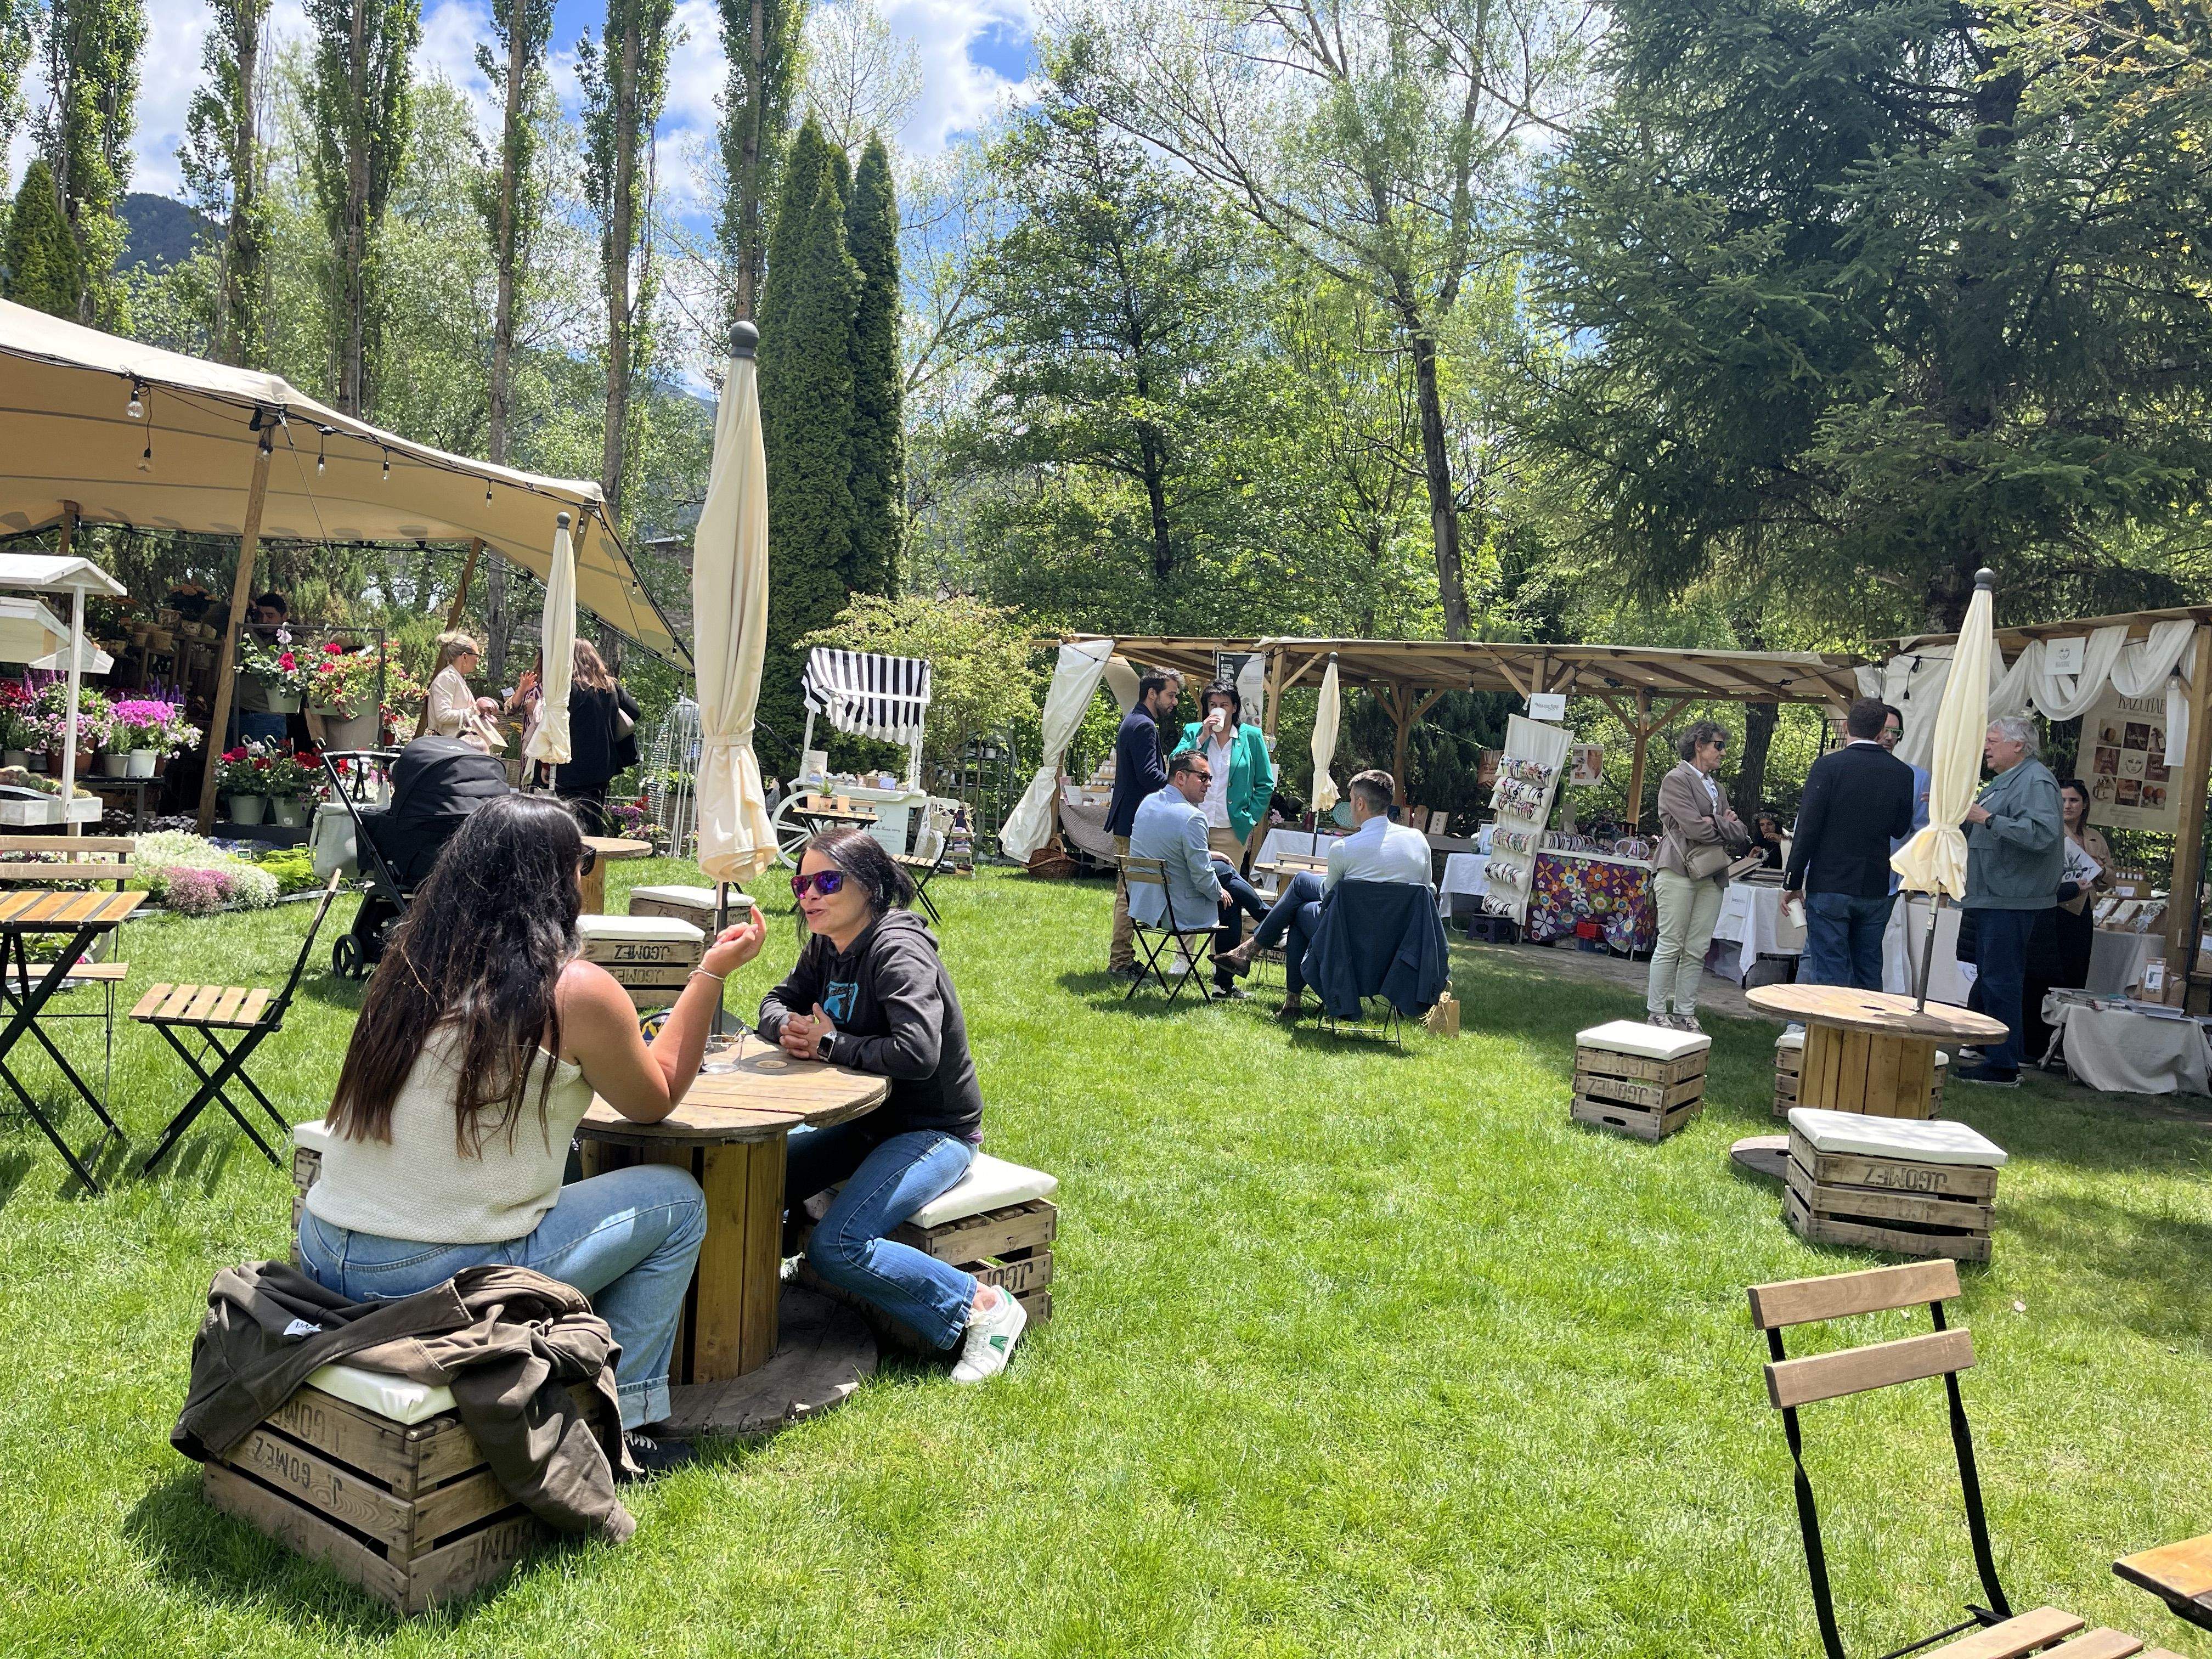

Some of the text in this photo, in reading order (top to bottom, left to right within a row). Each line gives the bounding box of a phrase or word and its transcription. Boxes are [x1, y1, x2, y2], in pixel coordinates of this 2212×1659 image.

[614, 944, 670, 960] J.GOMEZ
[1863, 1164, 1948, 1193] J.GOMEZ
[252, 1435, 311, 1489] GOMEZ
